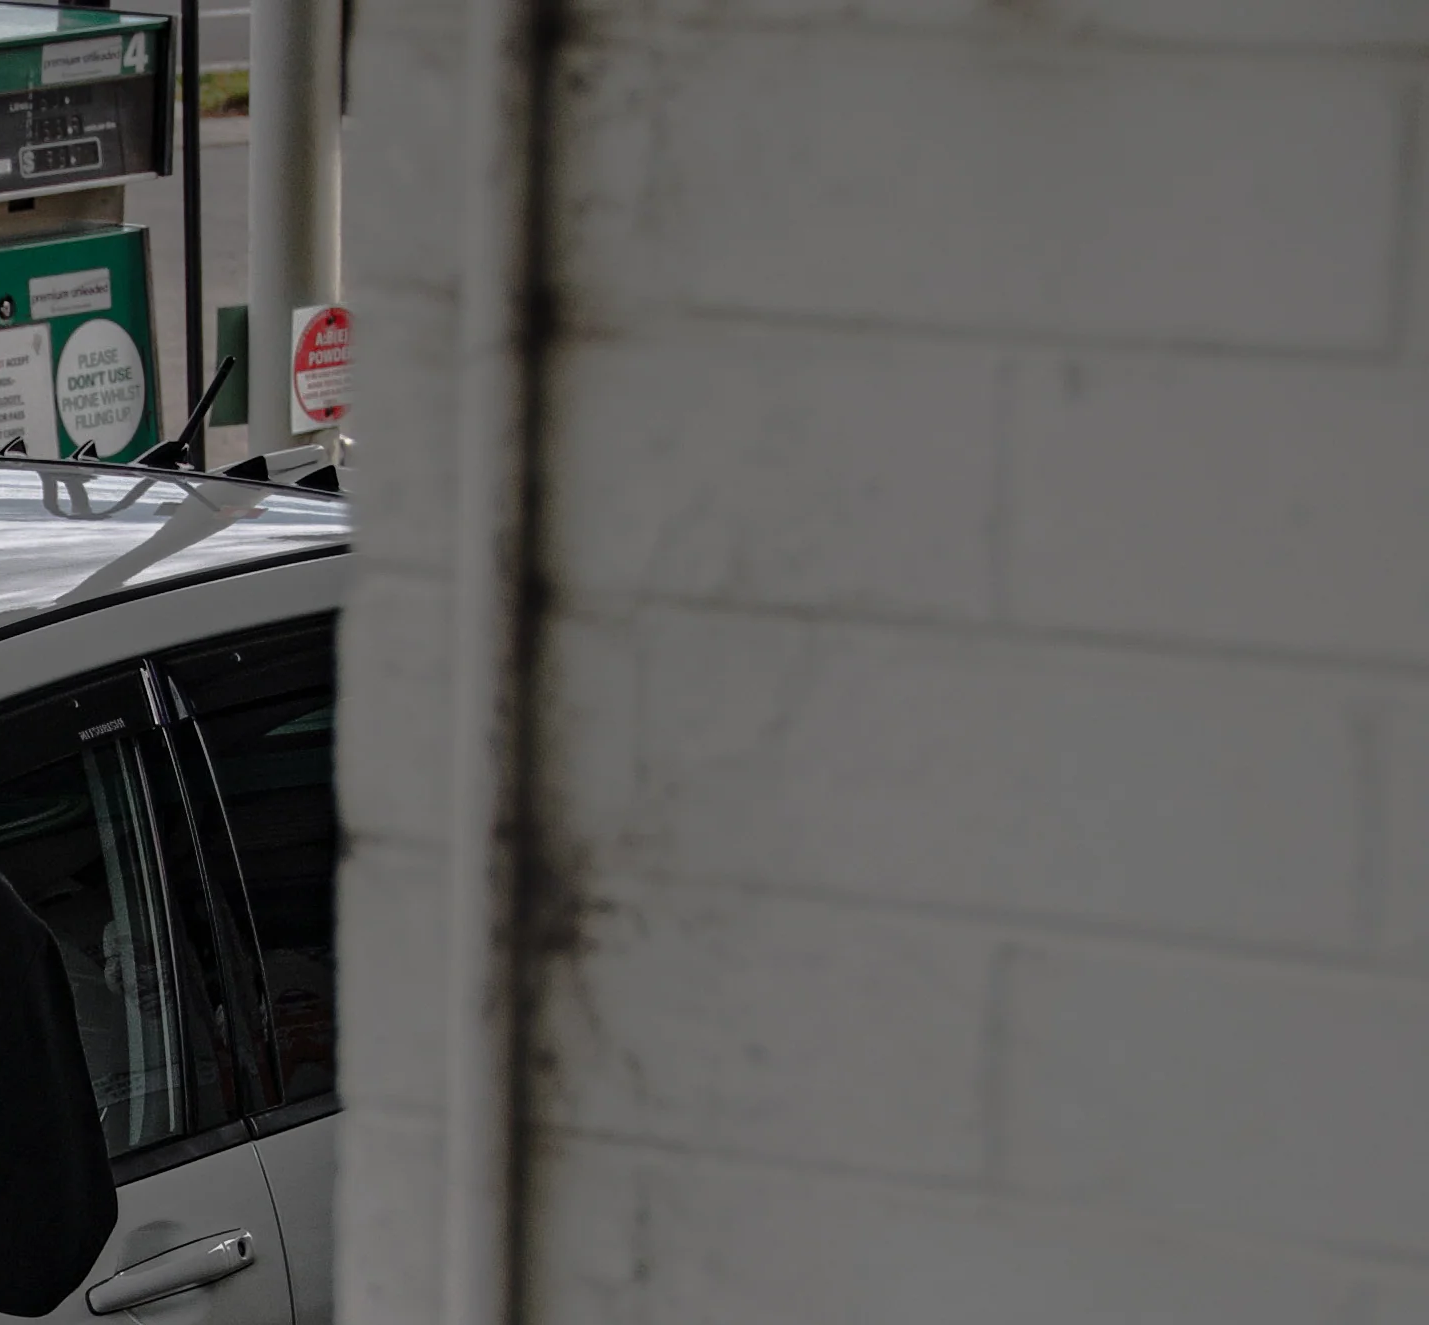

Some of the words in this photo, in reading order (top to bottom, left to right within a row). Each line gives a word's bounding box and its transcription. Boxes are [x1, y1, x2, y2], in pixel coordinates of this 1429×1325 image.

[123, 32, 149, 74] 4
[78, 348, 118, 369] PLEASE
[68, 371, 106, 391] DON'T
[108, 366, 133, 383] USE
[62, 392, 100, 412] PHONE
[101, 385, 141, 406] WHILST
[76, 409, 114, 430] FILLING
[78, 718, 126, 741] MITSUBISHI
